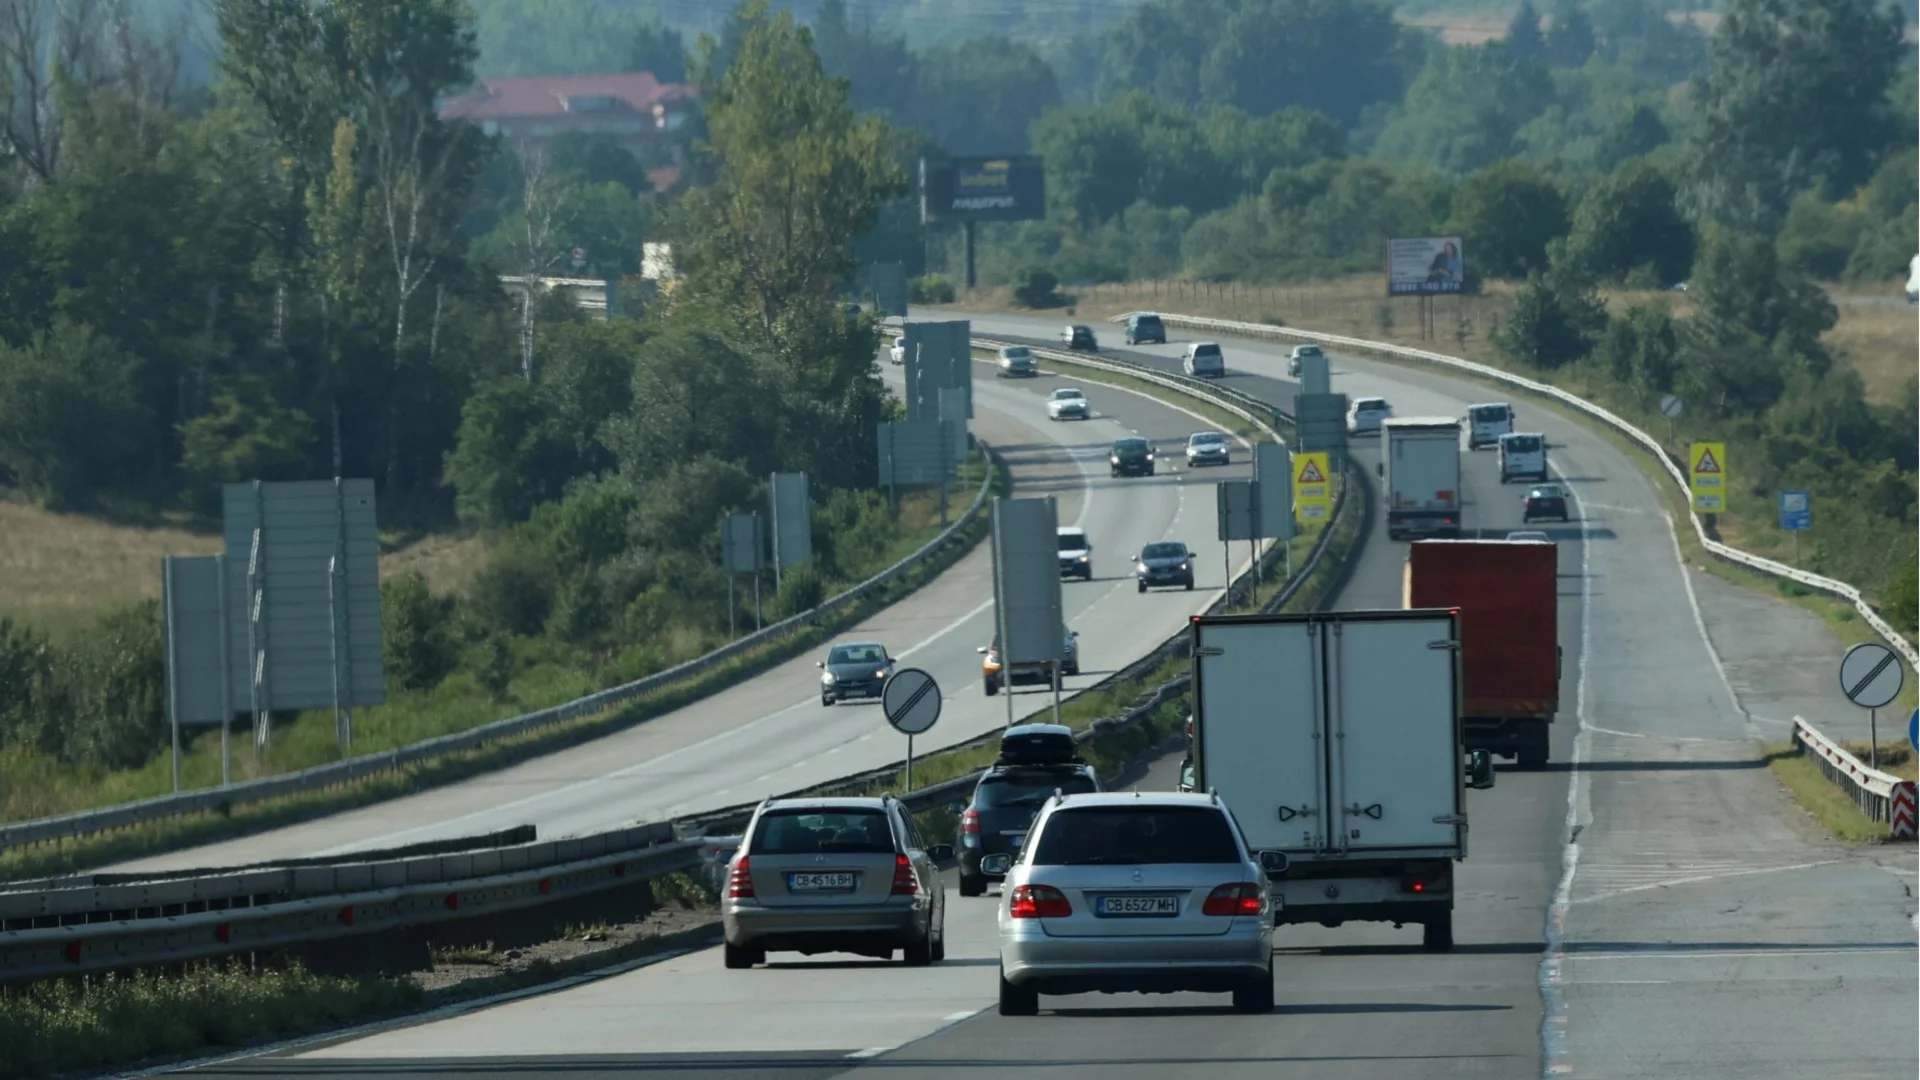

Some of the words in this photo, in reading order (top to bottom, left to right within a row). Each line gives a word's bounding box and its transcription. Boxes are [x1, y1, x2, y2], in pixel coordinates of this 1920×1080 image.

[797, 875, 809, 886] CB
[811, 875, 836, 886] 4516
[837, 874, 852, 885] BH
[1106, 898, 1123, 912] CB
[1125, 898, 1155, 912] 6527
[1157, 898, 1175, 911] MH
